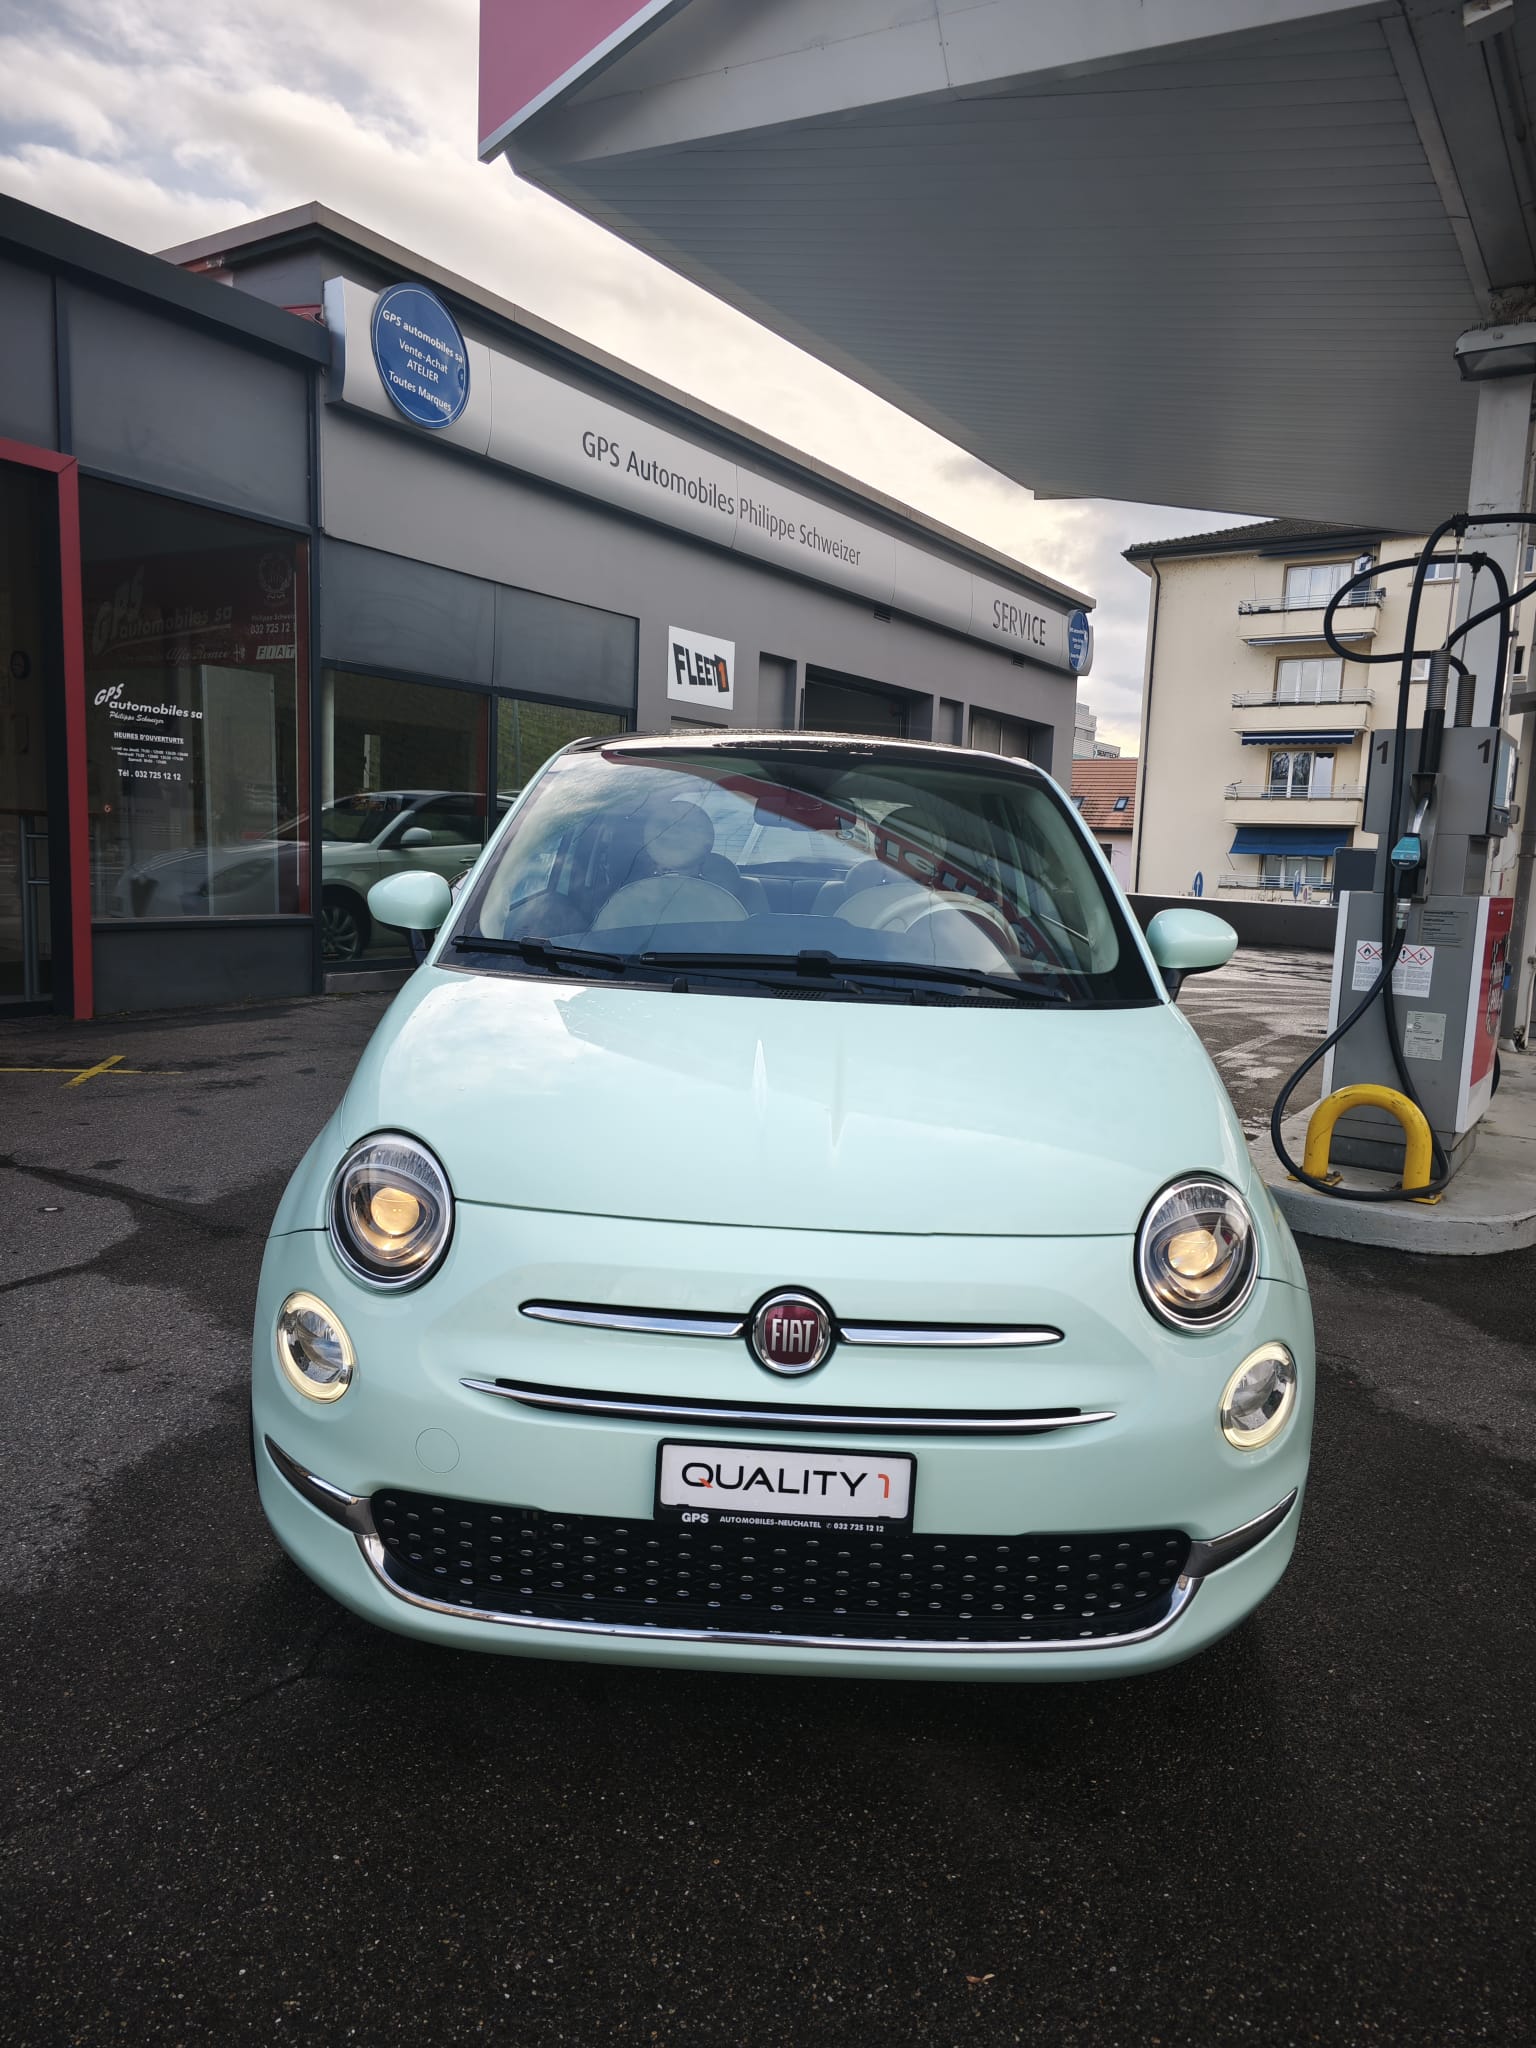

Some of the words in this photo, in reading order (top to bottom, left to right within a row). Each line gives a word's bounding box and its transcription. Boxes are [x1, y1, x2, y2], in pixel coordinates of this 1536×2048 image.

[382, 310, 401, 327] GPS
[403, 321, 453, 357] automobiles
[454, 352, 463, 363] sa
[399, 338, 448, 375] Vente-Achat
[406, 359, 439, 384] ATELIER
[388, 370, 416, 393] Toutes
[418, 385, 451, 412] Marques
[582, 431, 620, 468] GPS
[626, 450, 735, 515] Automobiles
[740, 498, 796, 540] Philippe
[799, 524, 861, 566] Schweizer
[992, 599, 1047, 647] SERVICE
[94, 682, 125, 706] GPS
[108, 700, 189, 718] automobiles
[190, 711, 203, 720] sa
[113, 731, 139, 741] HEURES
[1376, 740, 1390, 765] 1
[1477, 738, 1492, 764] 1
[117, 768, 130, 777] Tél
[134, 770, 148, 779] 032
[149, 771, 162, 780] 725
[163, 772, 172, 780] 12
[173, 773, 182, 781] 12
[771, 1317, 815, 1353] FIAT
[681, 1462, 868, 1498] QUALITY
[877, 1473, 890, 1499] 1
[681, 1512, 709, 1524] GPS
[720, 1515, 822, 1529] AUTOMOBILES-NEUCHATEL
[833, 1522, 848, 1531] 032
[849, 1523, 864, 1532] 725
[866, 1524, 874, 1532] 12
[875, 1524, 885, 1533] 12
